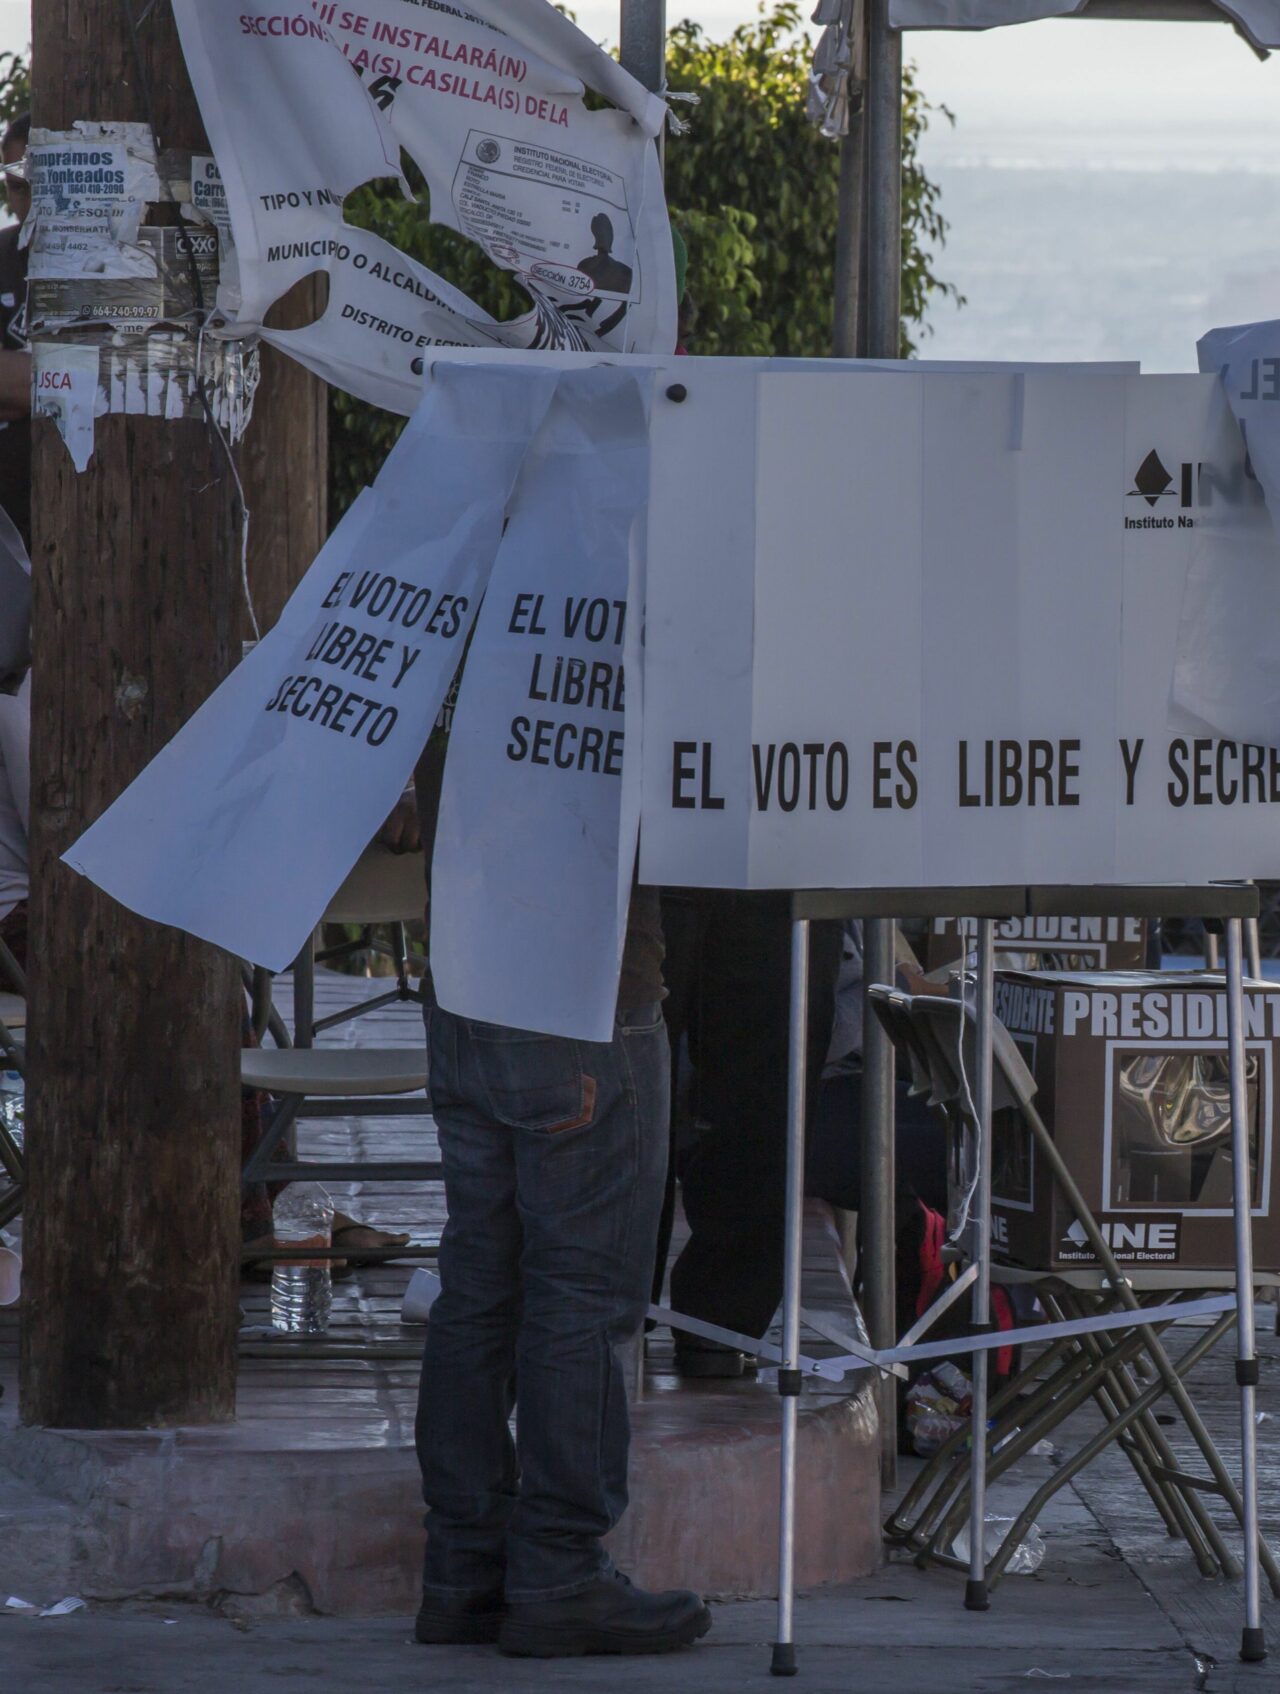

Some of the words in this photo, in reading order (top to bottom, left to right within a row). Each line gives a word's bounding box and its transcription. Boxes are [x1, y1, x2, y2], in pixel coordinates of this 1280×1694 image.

[239, 14, 329, 42] SECCIÓN:
[339, 12, 369, 35] SE
[371, 21, 527, 82] INSTALARÁ(N)
[406, 65, 520, 114] CASILLA(S)
[525, 95, 548, 120] DE
[549, 103, 569, 127] LA
[47, 168, 125, 184] Yonkeados
[514, 145, 549, 161] INSTITUTO
[550, 155, 582, 172] NACIONAL
[582, 165, 613, 183] ELECTORAL
[259, 192, 300, 211] TIPO
[301, 190, 312, 206] Y
[353, 253, 368, 269] O
[568, 275, 592, 291] 3754
[92, 305, 159, 318] 664-240-99-97
[340, 304, 414, 343] DISTRITO
[1181, 462, 1244, 507] IN
[1124, 516, 1174, 529] Instituto
[349, 570, 432, 628] VOTO
[425, 594, 469, 638] ES
[508, 593, 547, 635] EL
[564, 596, 627, 645] VOT
[305, 622, 394, 682] LIBRE
[391, 645, 421, 689] Y
[265, 675, 399, 746] SECRETO
[507, 715, 625, 776] SECRE
[671, 741, 725, 810] EL
[752, 741, 849, 812] VOTO
[872, 739, 918, 810] ES
[958, 739, 1081, 808] LIBRE
[1119, 738, 1144, 806] Y
[933, 916, 1142, 943] PRSIDENTE
[1101, 1223, 1178, 1249] INE
[1058, 1251, 1096, 1260] Instituto
[1136, 1251, 1176, 1260] Electoral
